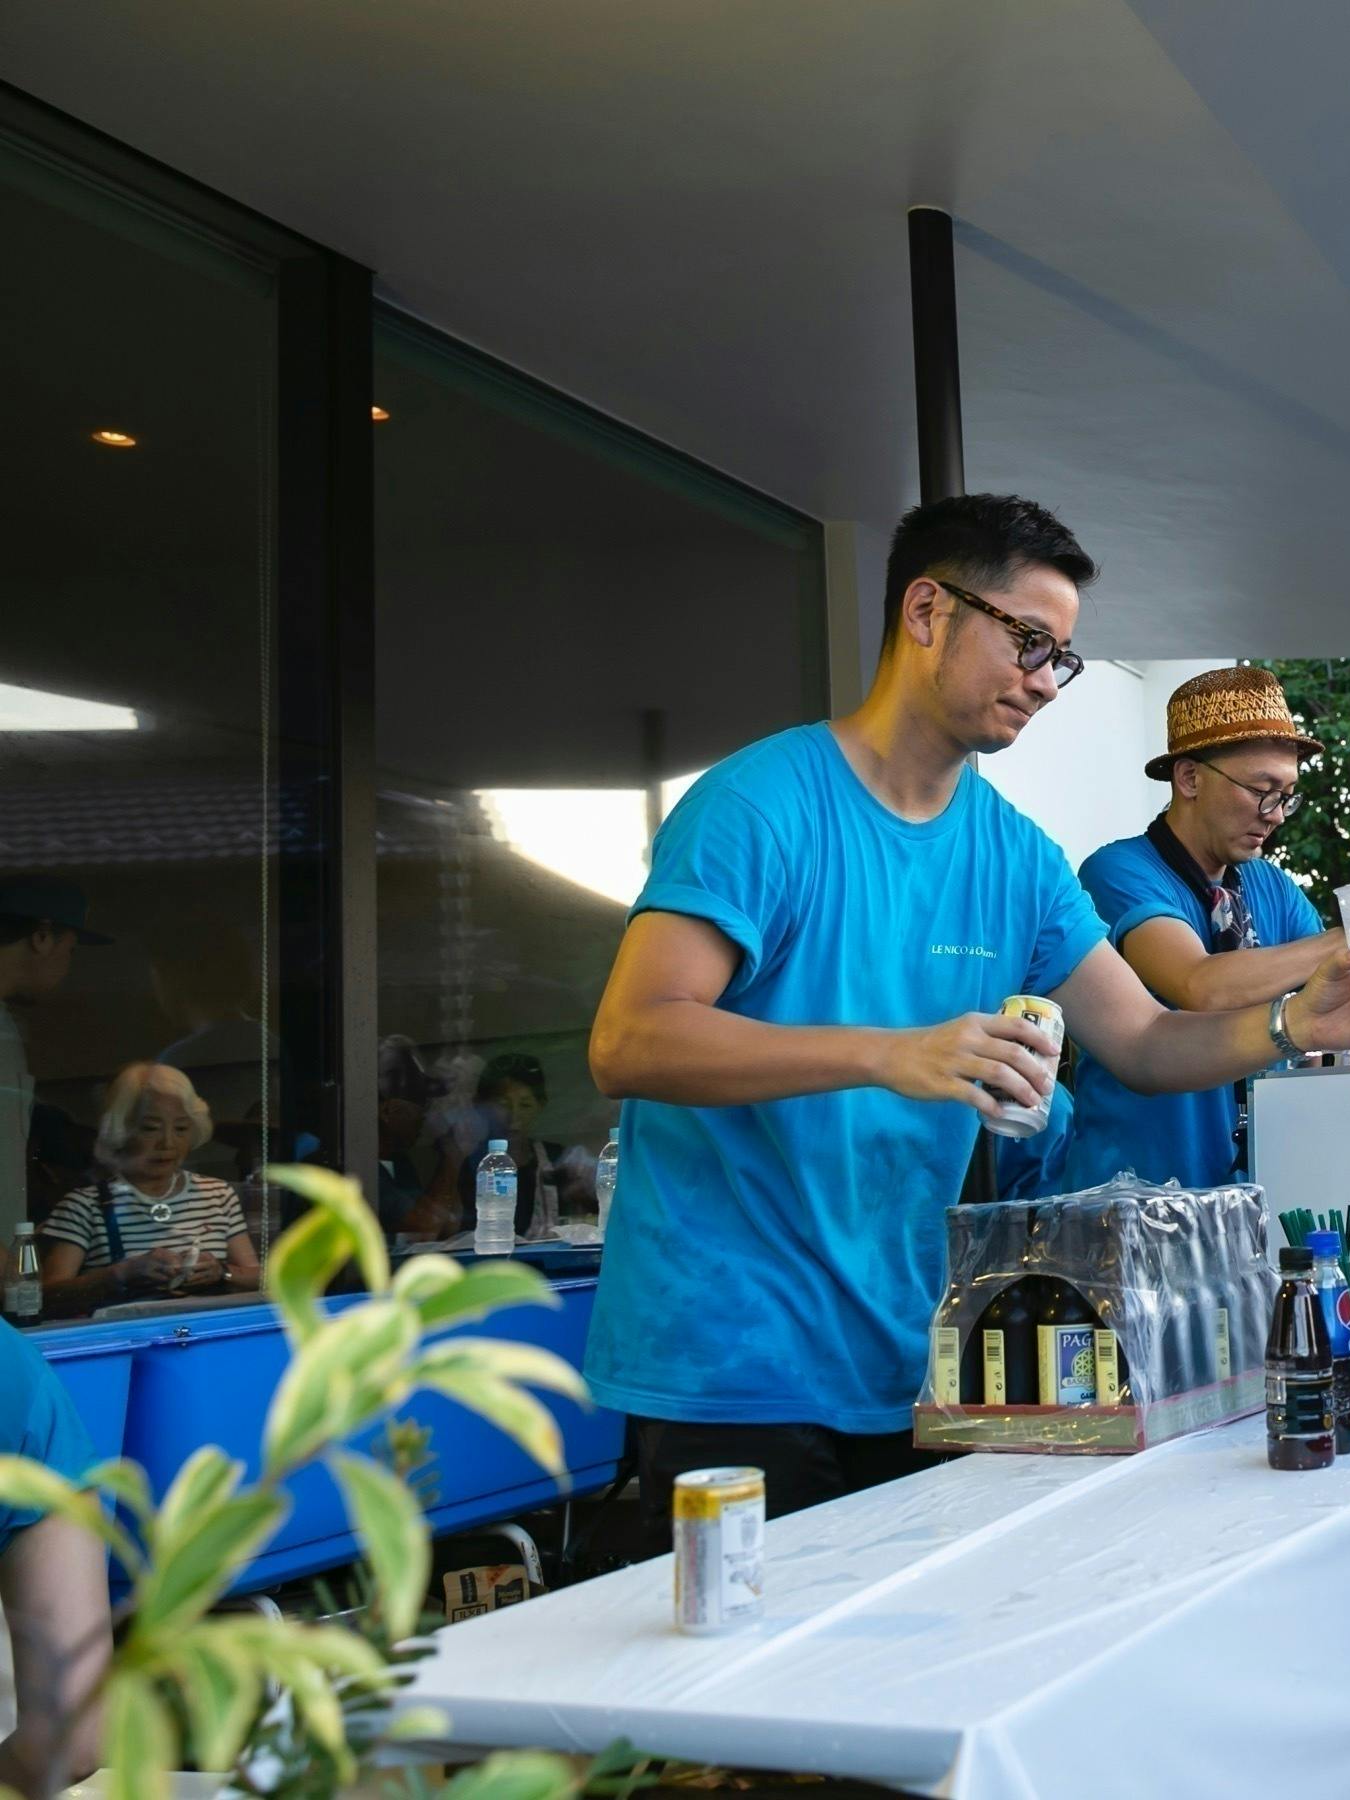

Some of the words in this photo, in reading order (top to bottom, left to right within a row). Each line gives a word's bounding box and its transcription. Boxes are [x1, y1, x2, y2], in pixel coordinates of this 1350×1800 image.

[932, 945, 943, 954] LE
[945, 945, 968, 955] NICO
[1063, 1333, 1092, 1347] PAG
